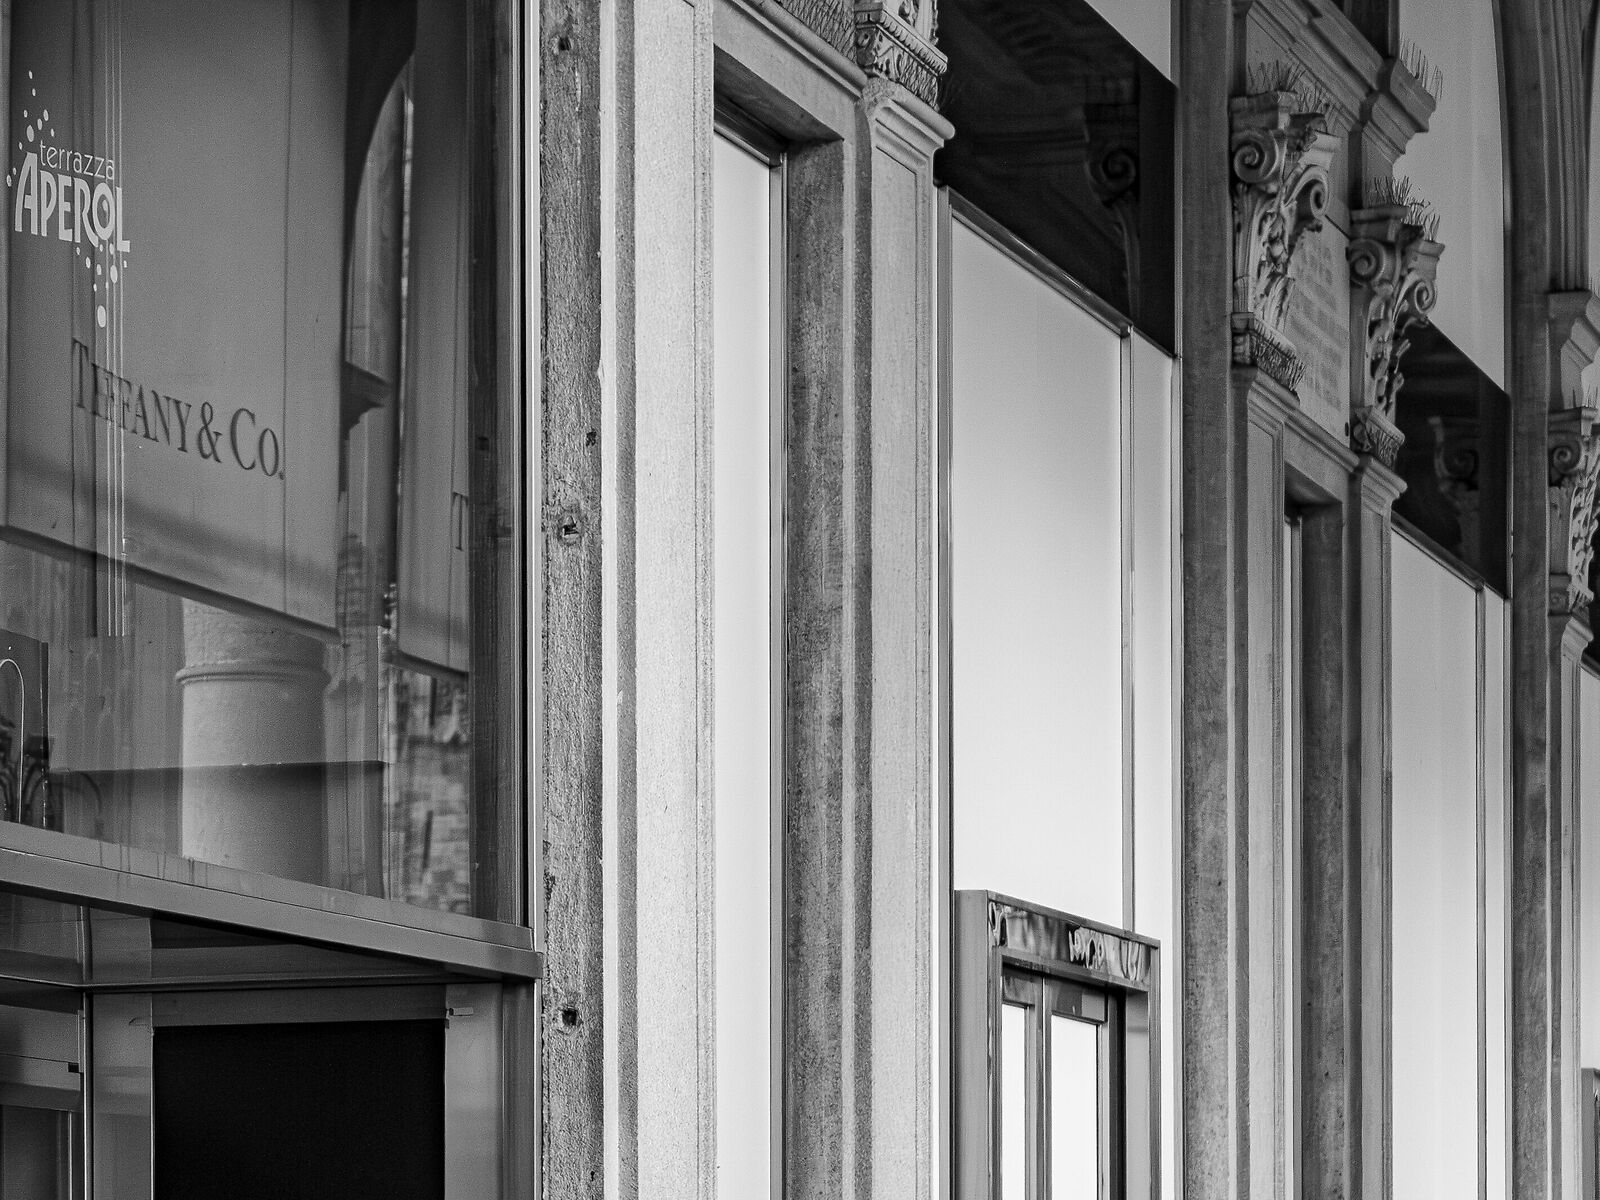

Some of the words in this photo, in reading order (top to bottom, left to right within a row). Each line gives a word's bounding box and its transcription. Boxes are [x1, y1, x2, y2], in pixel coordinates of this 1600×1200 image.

[40, 140, 115, 180] terrazza
[15, 151, 130, 253] APEROL
[198, 401, 222, 464] &
